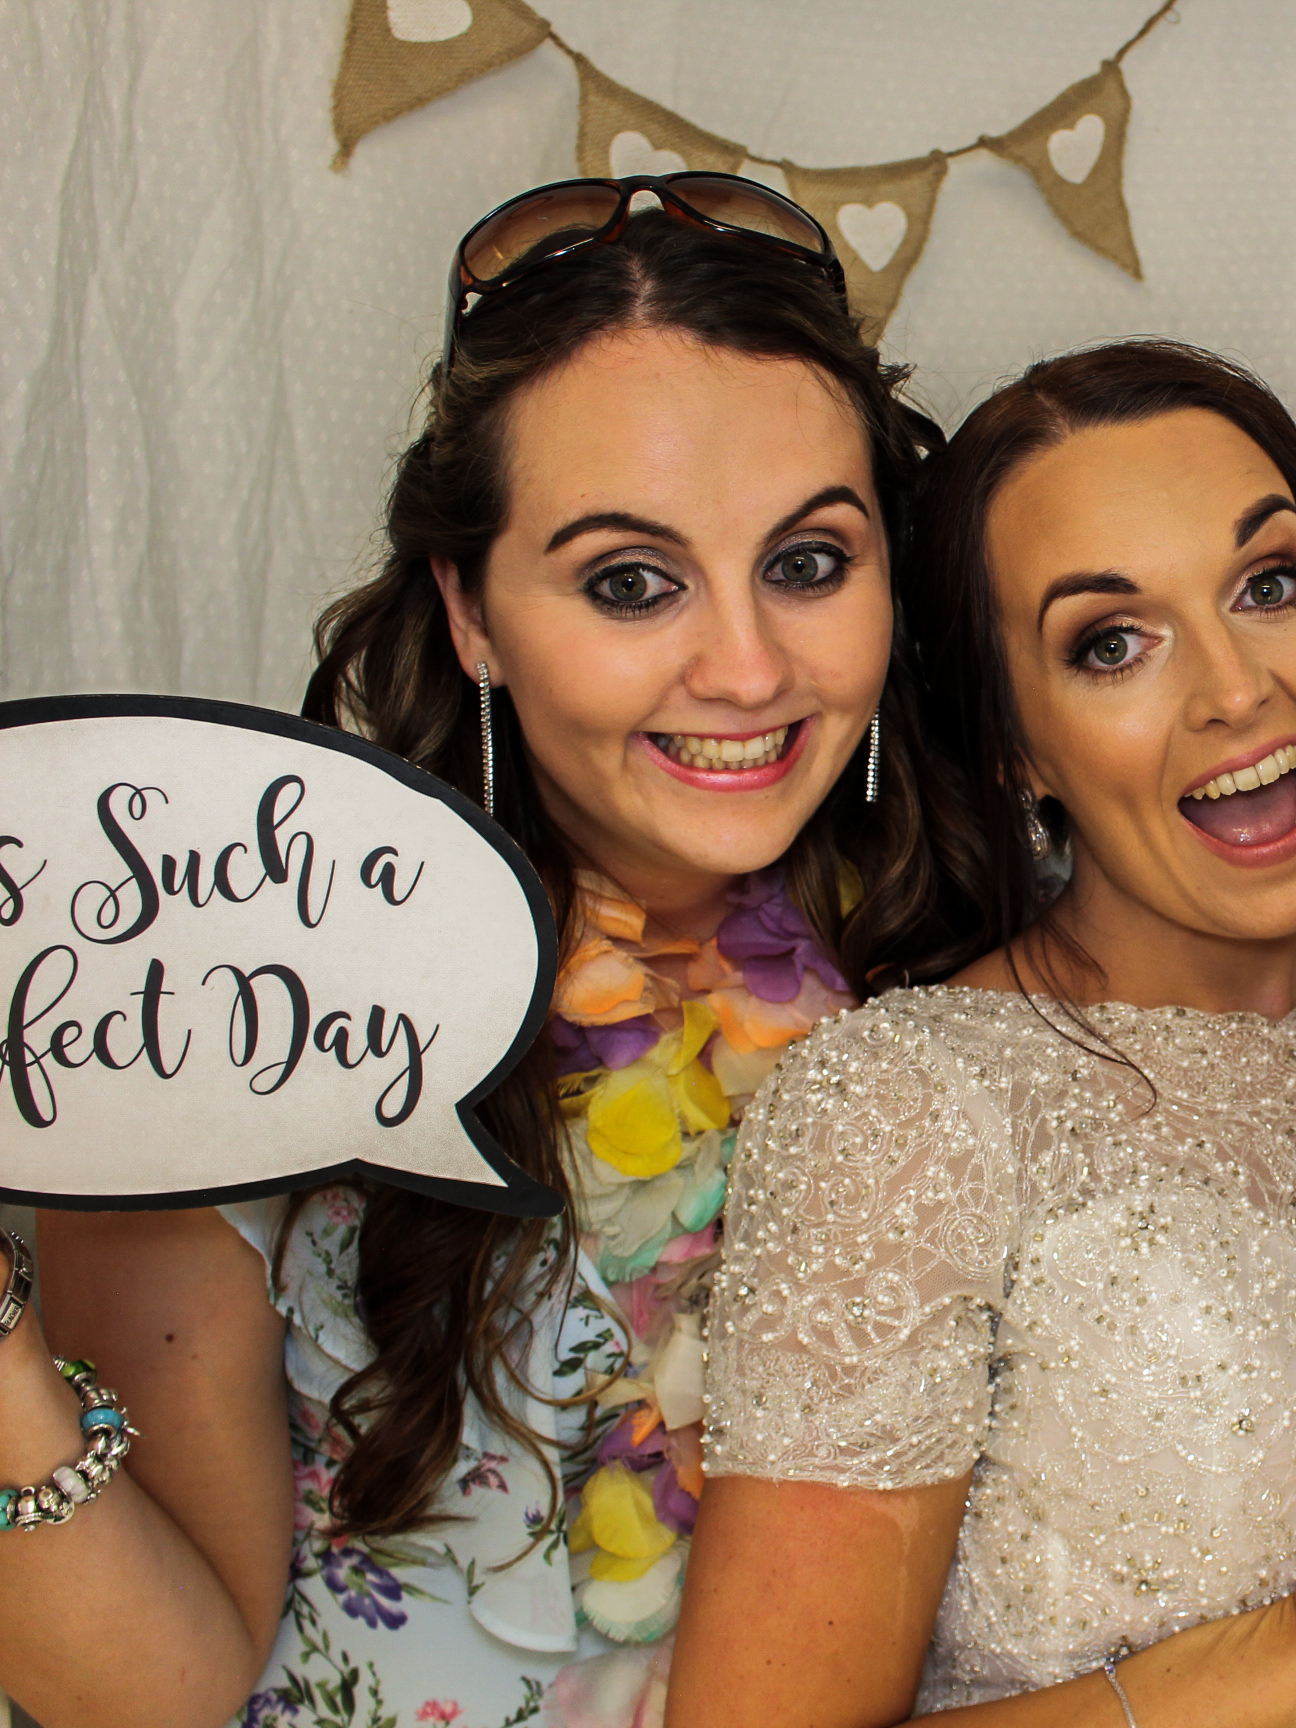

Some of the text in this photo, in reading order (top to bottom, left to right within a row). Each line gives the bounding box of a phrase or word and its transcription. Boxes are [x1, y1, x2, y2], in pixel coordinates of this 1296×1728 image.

[71, 774, 336, 945] Such
[360, 845, 425, 906] a
[0, 944, 440, 1129] fect Day
